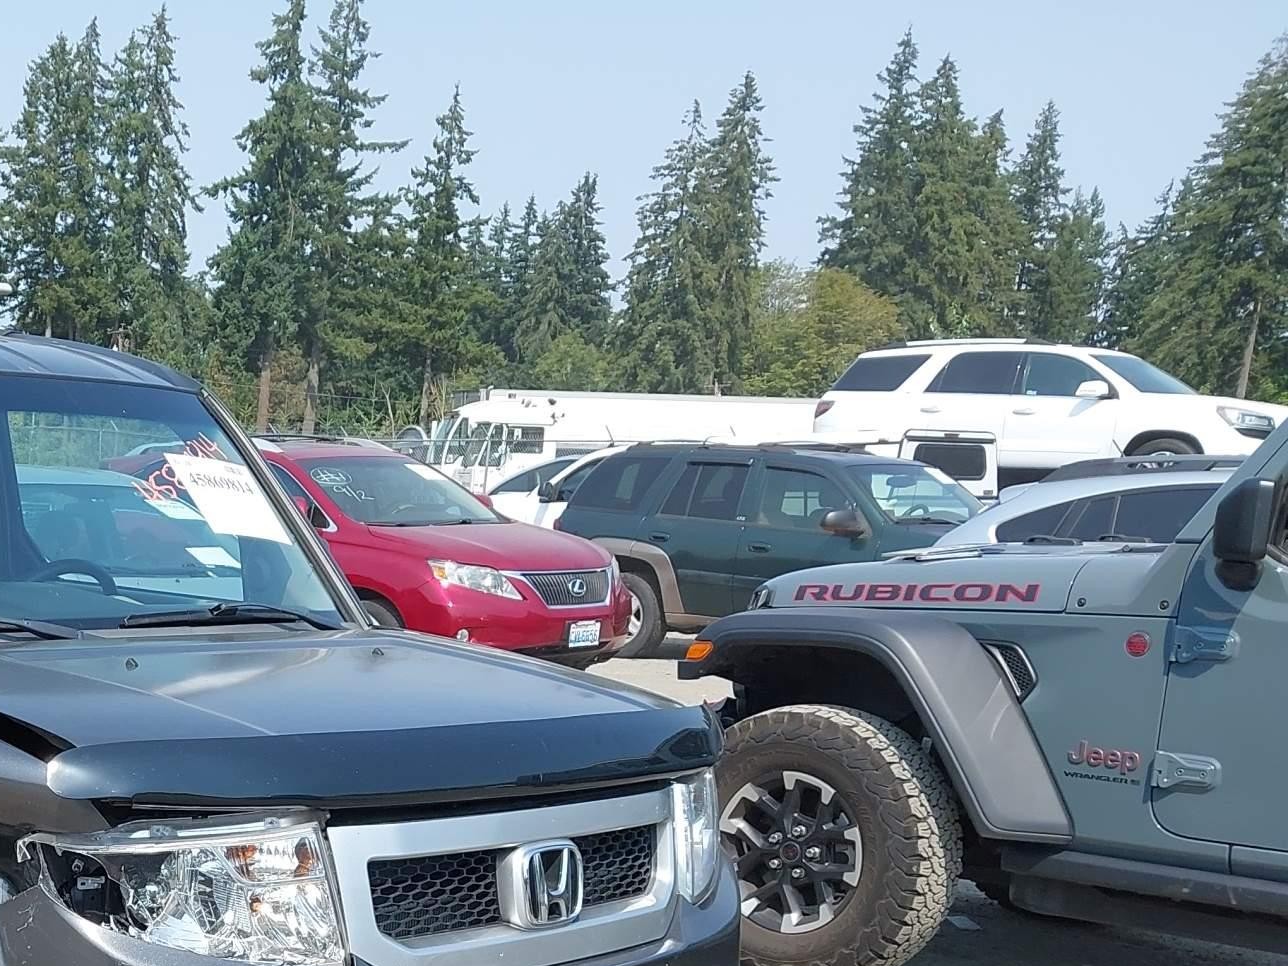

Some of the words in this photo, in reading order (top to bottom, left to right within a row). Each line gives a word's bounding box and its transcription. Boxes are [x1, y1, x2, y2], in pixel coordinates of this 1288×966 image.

[189, 472, 254, 495] 45869814
[332, 484, 375, 503] 9/2
[792, 582, 1041, 603] RUBICON
[1067, 739, 1140, 776] Jeep
[1063, 770, 1129, 785] WRANGLER
